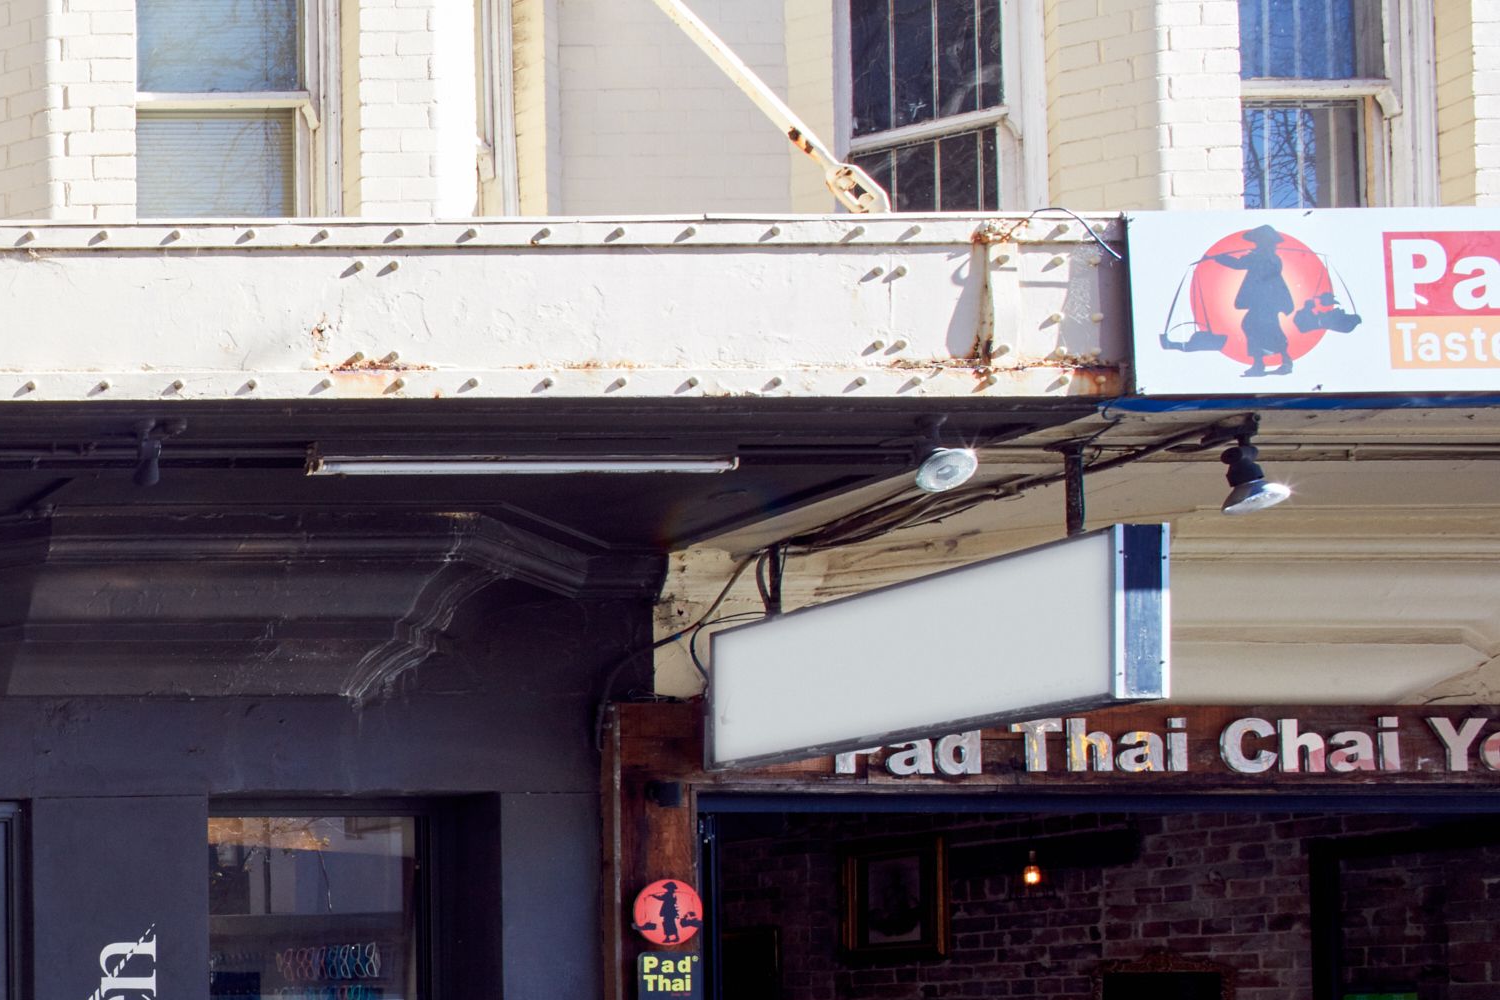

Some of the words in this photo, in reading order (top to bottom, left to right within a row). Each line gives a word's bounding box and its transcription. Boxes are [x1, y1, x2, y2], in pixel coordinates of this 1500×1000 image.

[1011, 717, 1188, 772] Thai
[1218, 716, 1401, 773] Chai
[643, 974, 692, 992] Thai
